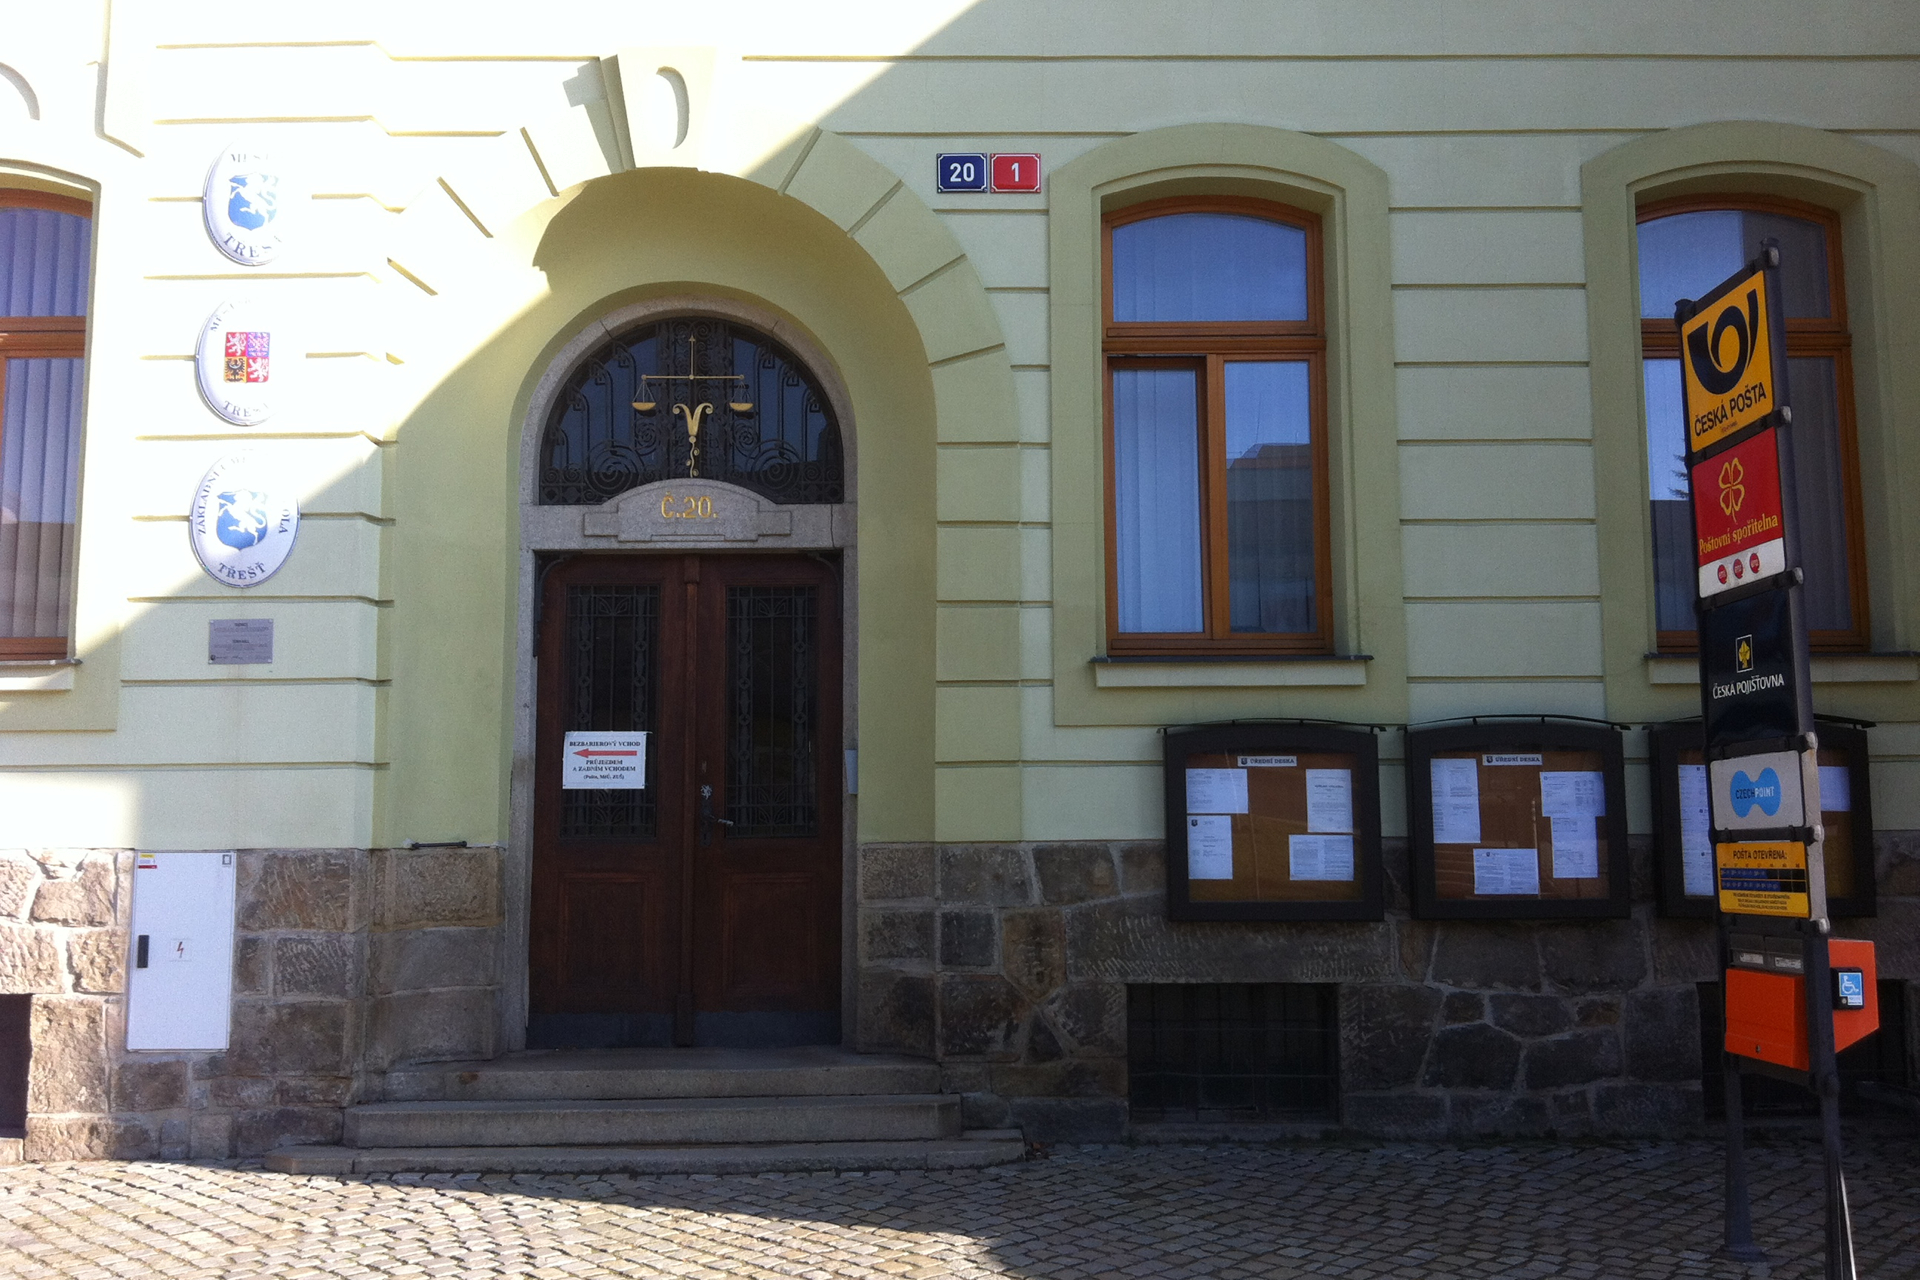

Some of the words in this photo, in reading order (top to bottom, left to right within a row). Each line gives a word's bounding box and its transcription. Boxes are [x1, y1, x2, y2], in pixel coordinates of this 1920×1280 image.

[949, 162, 975, 182] 20
[1011, 162, 1020, 182] 1
[1694, 399, 1728, 437] ČESKÁ
[1729, 382, 1767, 417] POŠTA
[1700, 527, 1731, 556] Poštovní
[1732, 513, 1779, 545] spořitelna
[218, 561, 266, 580] TŘEŠŤ
[1712, 680, 1736, 700] ČESKÁ
[1732, 848, 1752, 859] POŠTA
